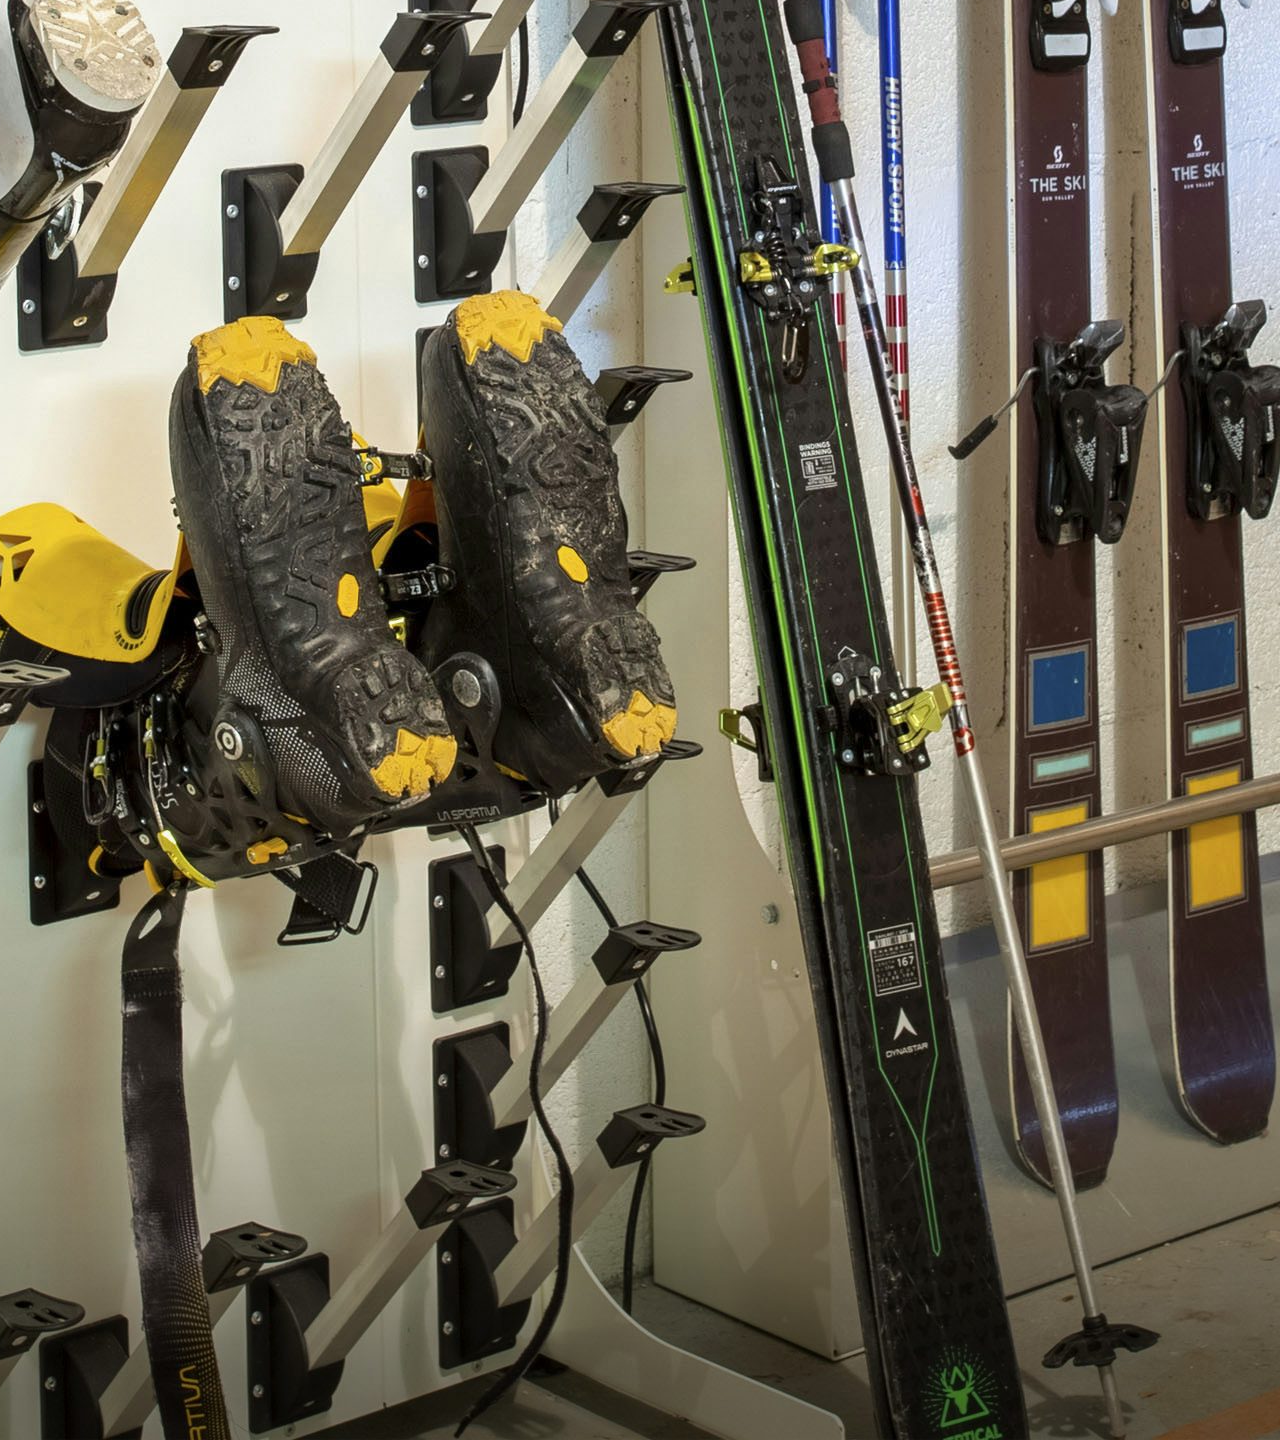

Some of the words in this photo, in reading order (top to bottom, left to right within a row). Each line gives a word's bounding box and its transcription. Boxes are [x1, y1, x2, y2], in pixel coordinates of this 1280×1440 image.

[1171, 164, 1199, 182] THE
[1203, 161, 1225, 178] SKI
[1029, 176, 1058, 193] THE
[1063, 174, 1086, 191] SKI
[799, 441, 831, 451] BINDINGS
[799, 447, 833, 458] WARNING
[451, 805, 501, 820] SPORTIVA
[896, 955, 915, 968] 167
[885, 1041, 929, 1058] DYNASTAR
